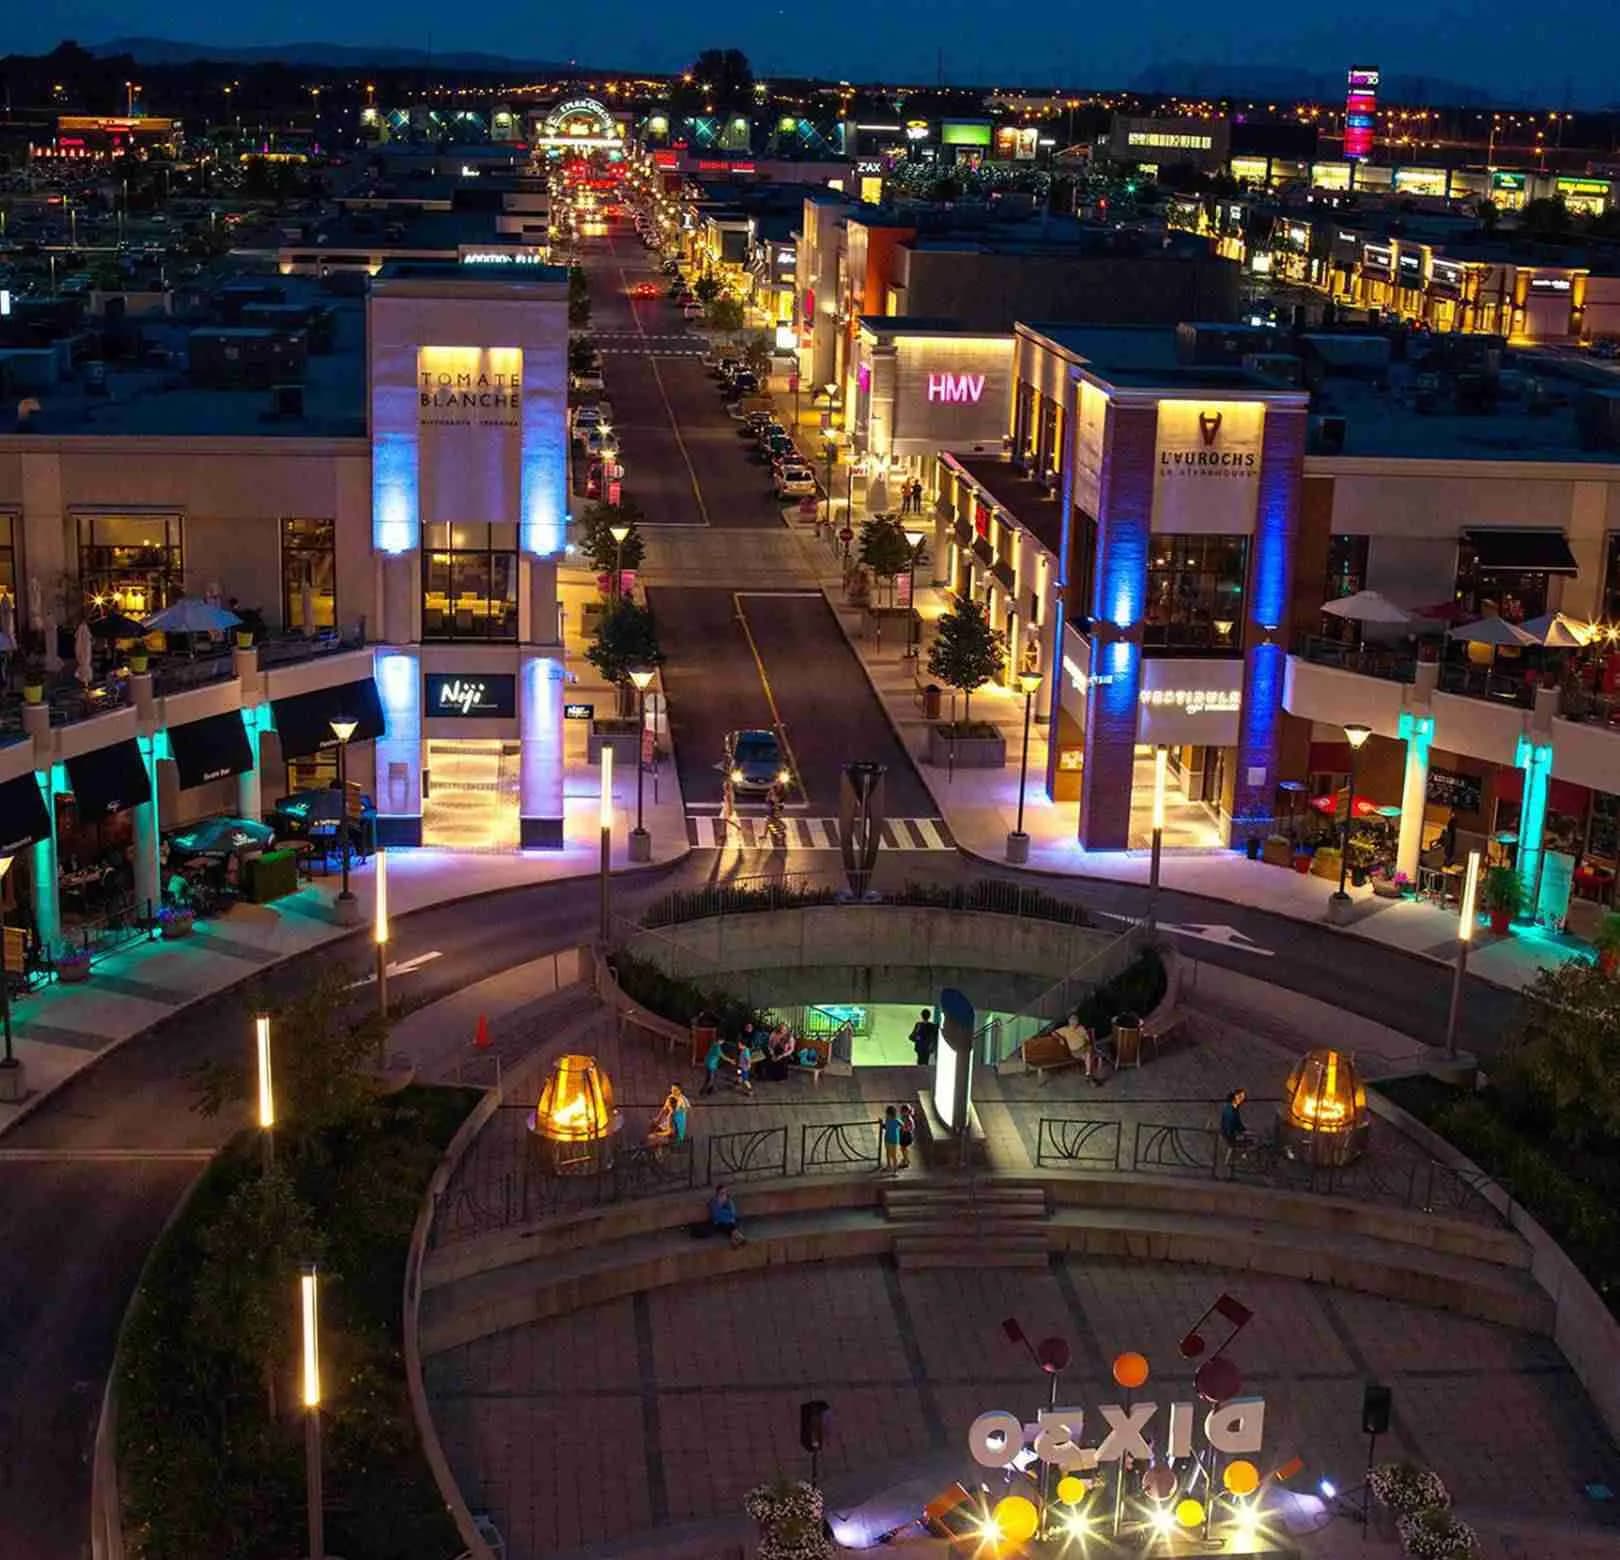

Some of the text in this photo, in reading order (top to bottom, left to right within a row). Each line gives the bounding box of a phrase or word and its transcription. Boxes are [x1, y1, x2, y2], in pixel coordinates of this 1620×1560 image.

[421, 372, 519, 387] TOMATE
[928, 373, 985, 402] HMV
[420, 392, 519, 408] BLANCHE
[439, 679, 487, 714] Niji
